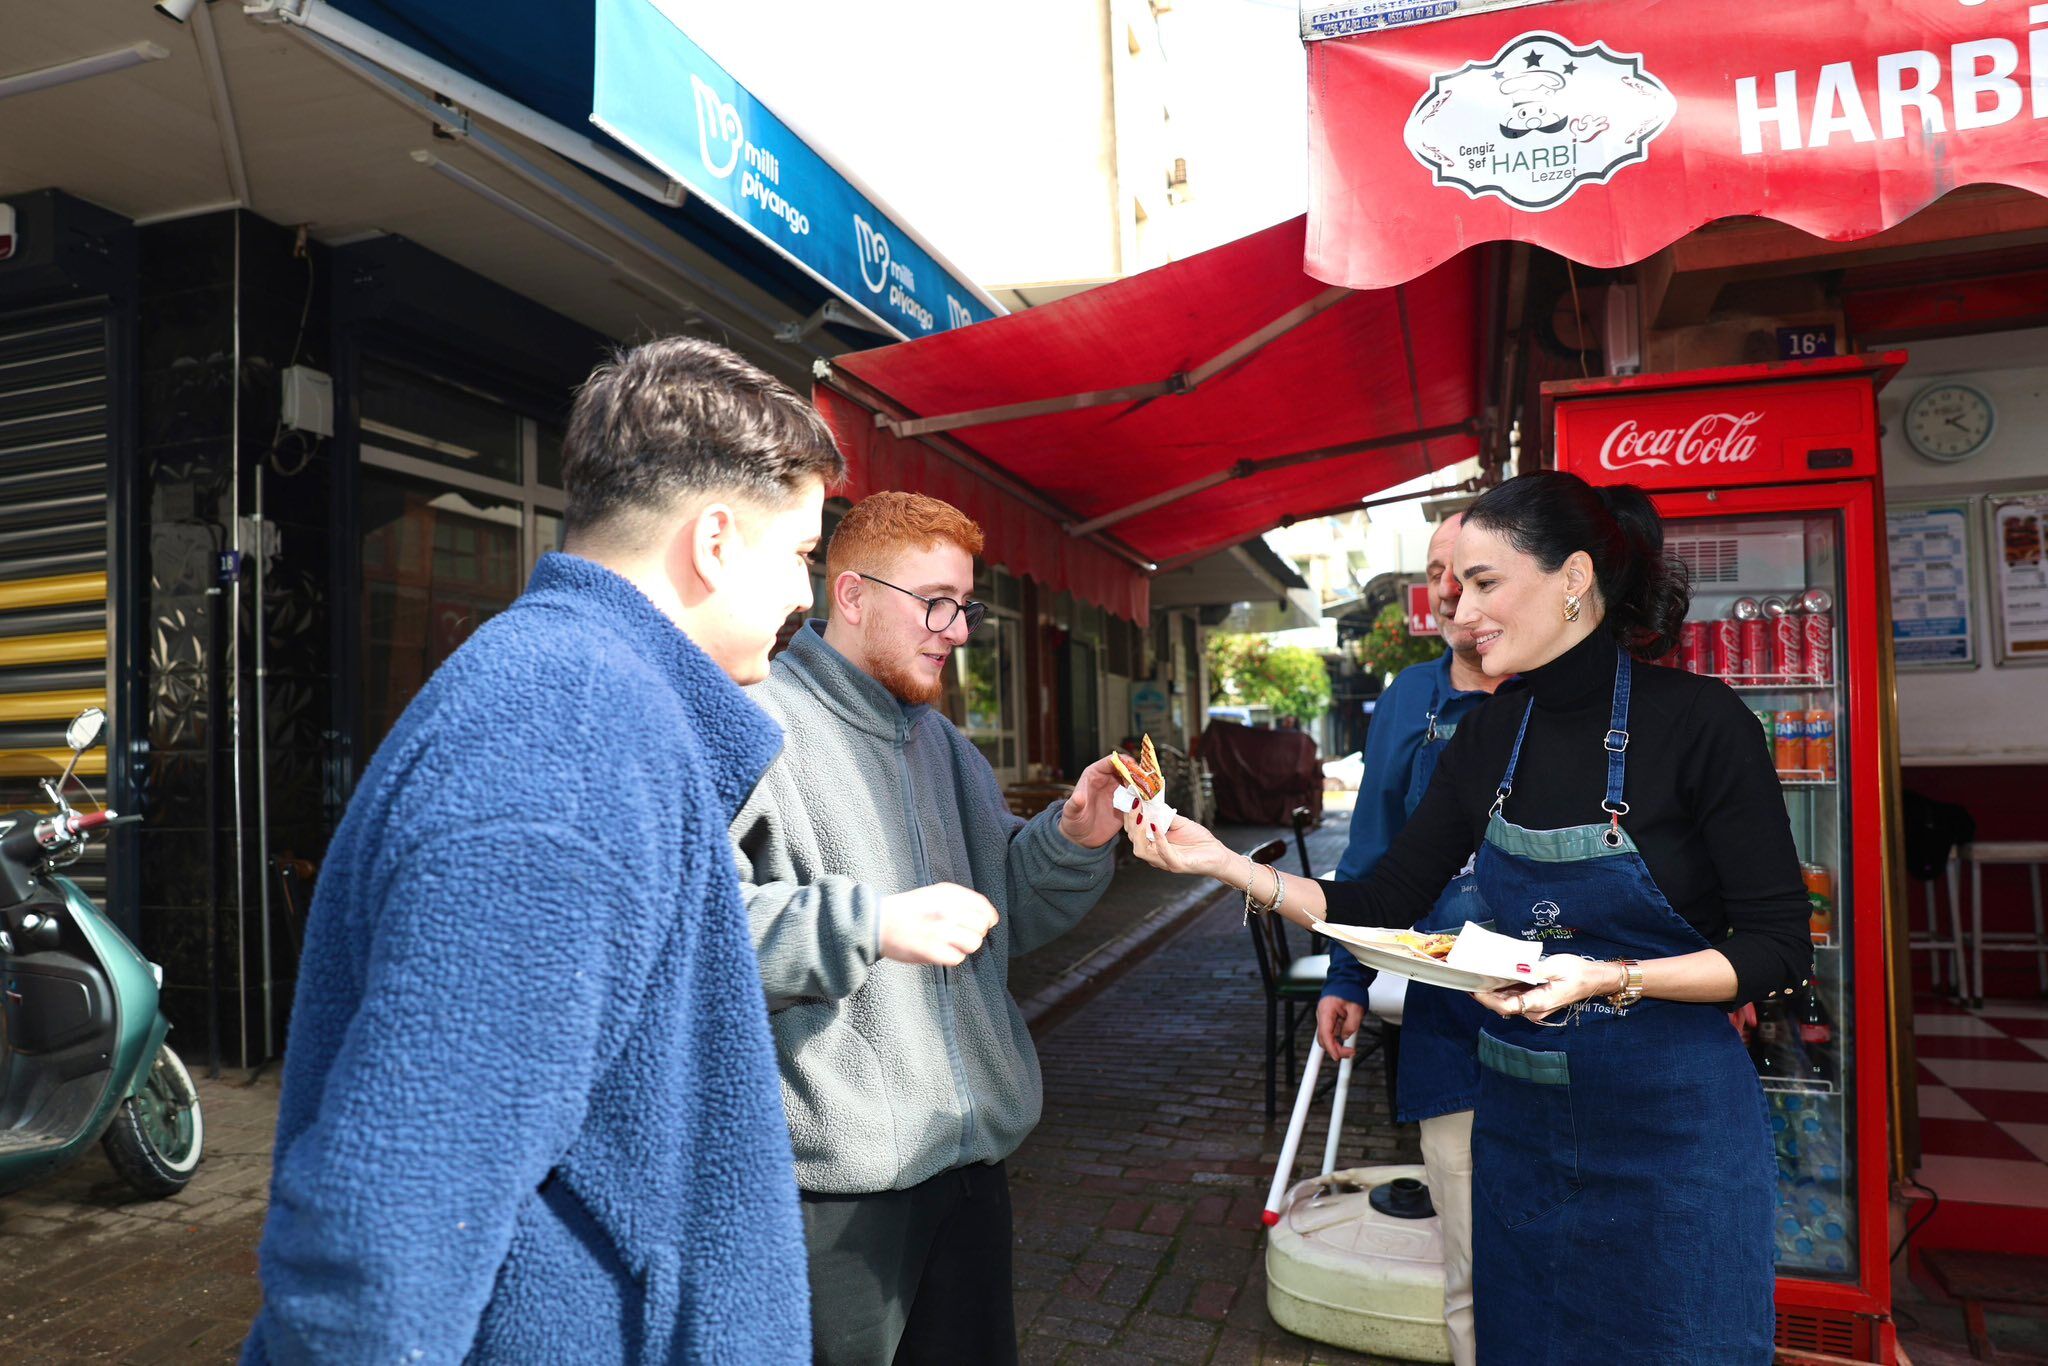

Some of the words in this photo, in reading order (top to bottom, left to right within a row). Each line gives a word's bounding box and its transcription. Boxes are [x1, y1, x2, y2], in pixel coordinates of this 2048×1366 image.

[744, 140, 780, 186] milli
[1459, 141, 1496, 157] Cengiz
[1468, 156, 1487, 172] Şef
[1492, 138, 1578, 175] HARBİ
[1531, 167, 1577, 183] Lezzet
[741, 170, 810, 236] piyango
[889, 285, 934, 330] piyango
[1599, 411, 1766, 471] Coca-Cola
